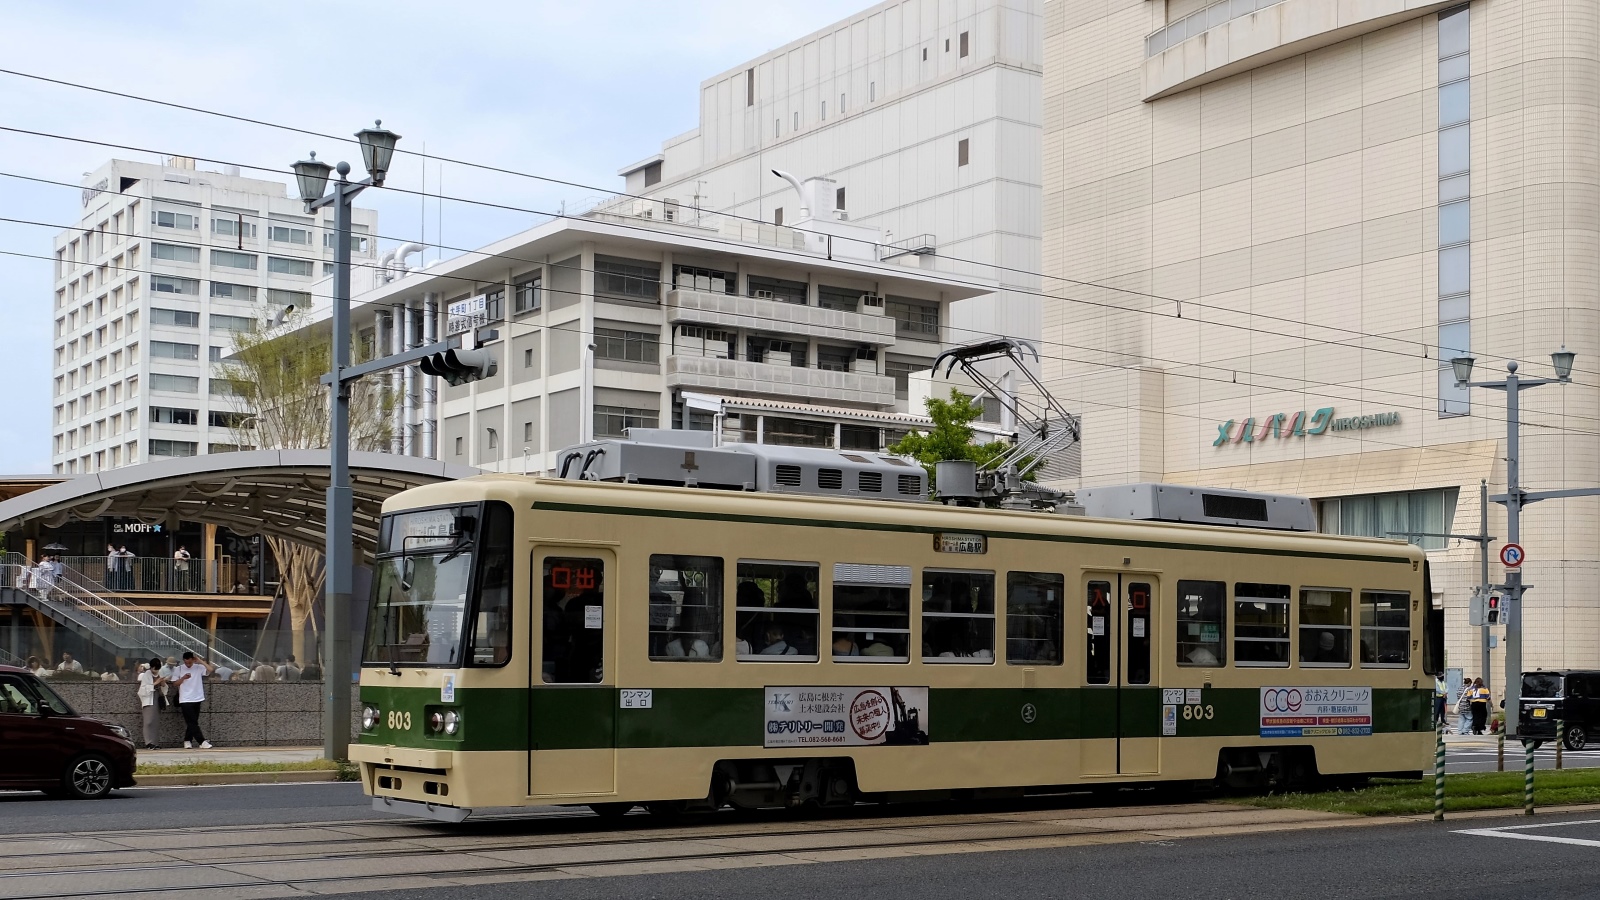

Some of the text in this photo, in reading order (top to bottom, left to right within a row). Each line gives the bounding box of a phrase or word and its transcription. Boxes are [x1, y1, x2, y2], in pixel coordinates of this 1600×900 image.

[1212, 406, 1402, 446] メルパルク HIROSHIMA
[124, 523, 152, 533] MOFF
[959, 541, 982, 553] 広島駅
[622, 690, 651, 699] ワンマン
[798, 692, 845, 702] 広島に根差す
[1164, 689, 1184, 697] ワンマン
[1304, 689, 1369, 702] おおえクリニック
[798, 703, 846, 714] 土木建設会社
[1182, 704, 1214, 720] 803
[388, 710, 412, 731] 803
